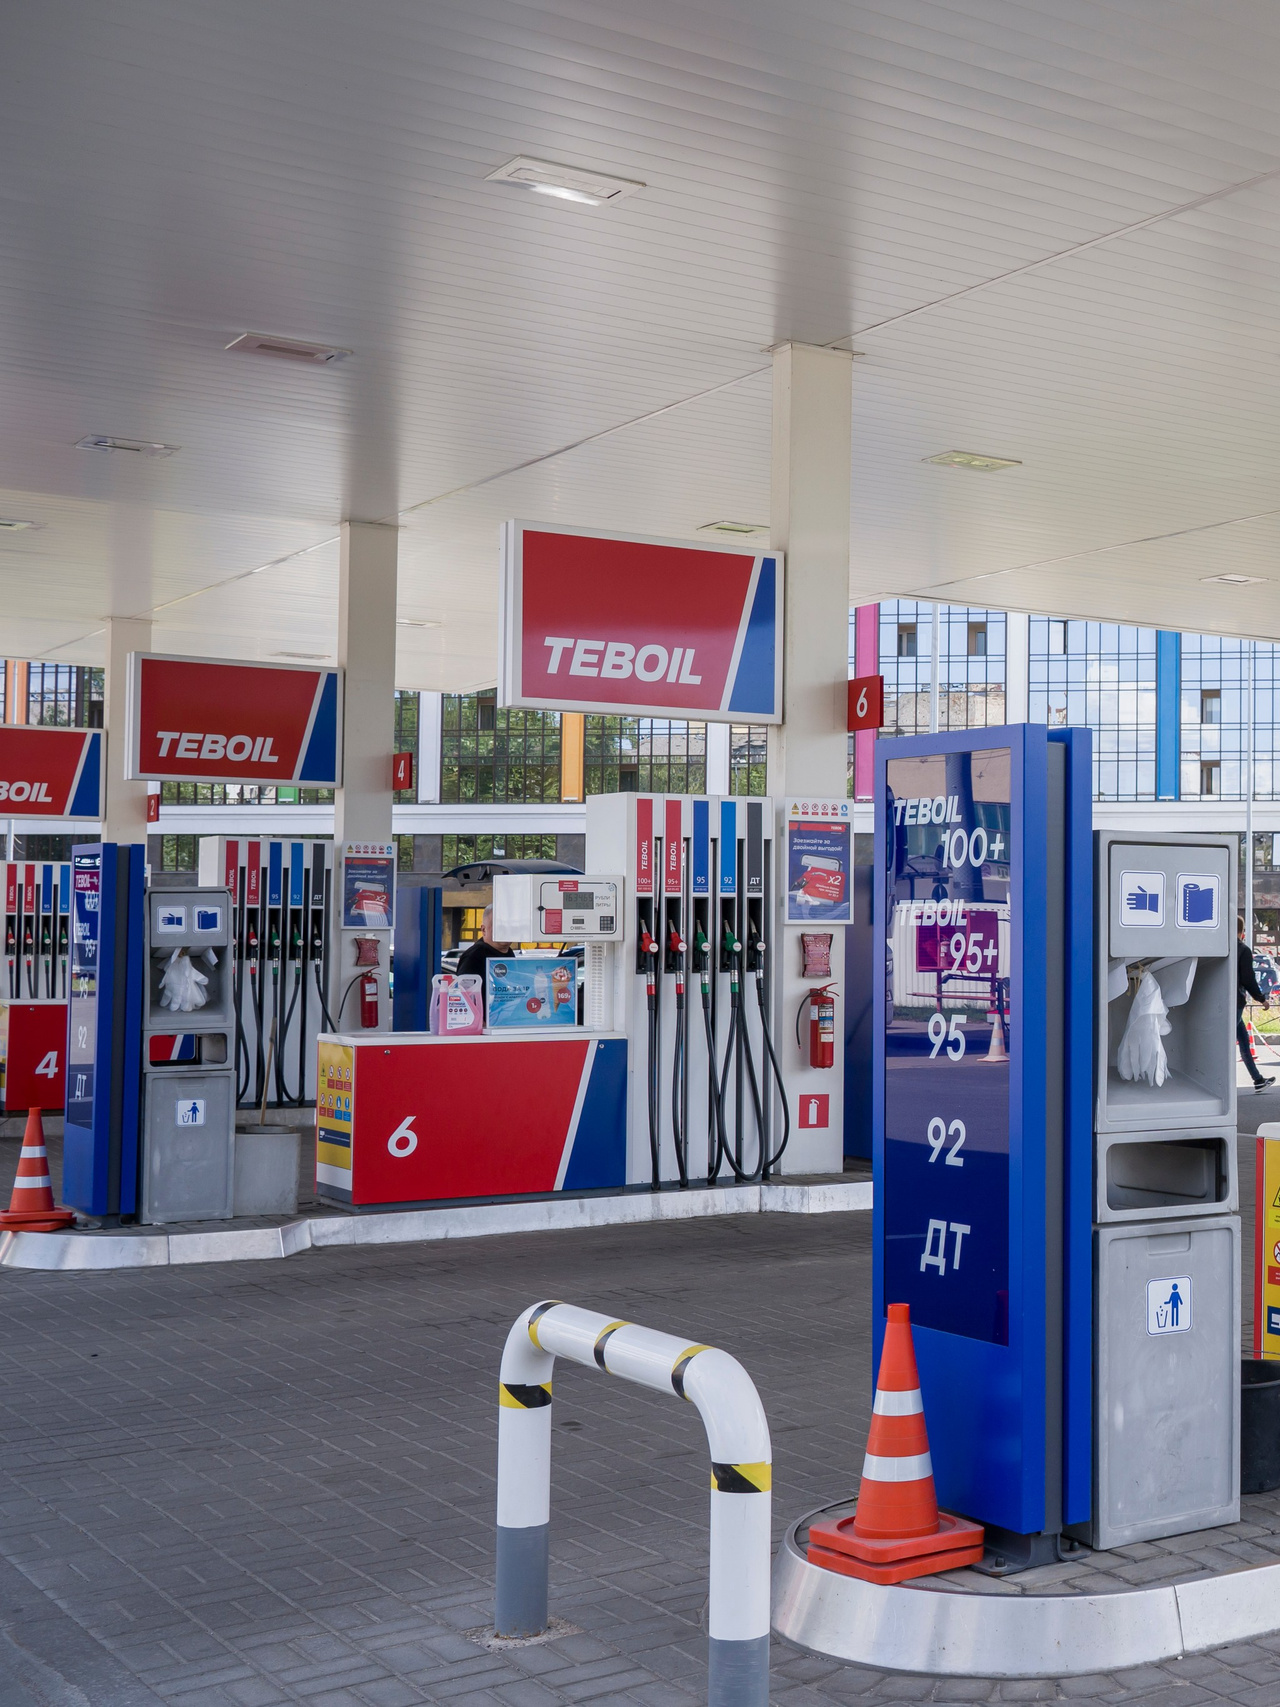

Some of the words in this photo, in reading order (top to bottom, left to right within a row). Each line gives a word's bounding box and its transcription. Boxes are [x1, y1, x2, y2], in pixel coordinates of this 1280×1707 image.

[544, 636, 702, 684] TEBOIL
[856, 688, 868, 718] 6
[156, 731, 279, 763] TEBOIL
[398, 760, 404, 780] 4
[894, 796, 962, 826] TEBOIL
[941, 827, 1004, 868] 100+
[899, 898, 968, 926] TEBOIL
[950, 933, 997, 973] 95+
[80, 977, 88, 999] 95
[78, 1026, 87, 1048] 92
[928, 1013, 967, 1062] 95
[35, 1051, 58, 1078] 4
[387, 1116, 418, 1158] 6
[927, 1117, 966, 1167] 92
[920, 1218, 971, 1276] ДТ
